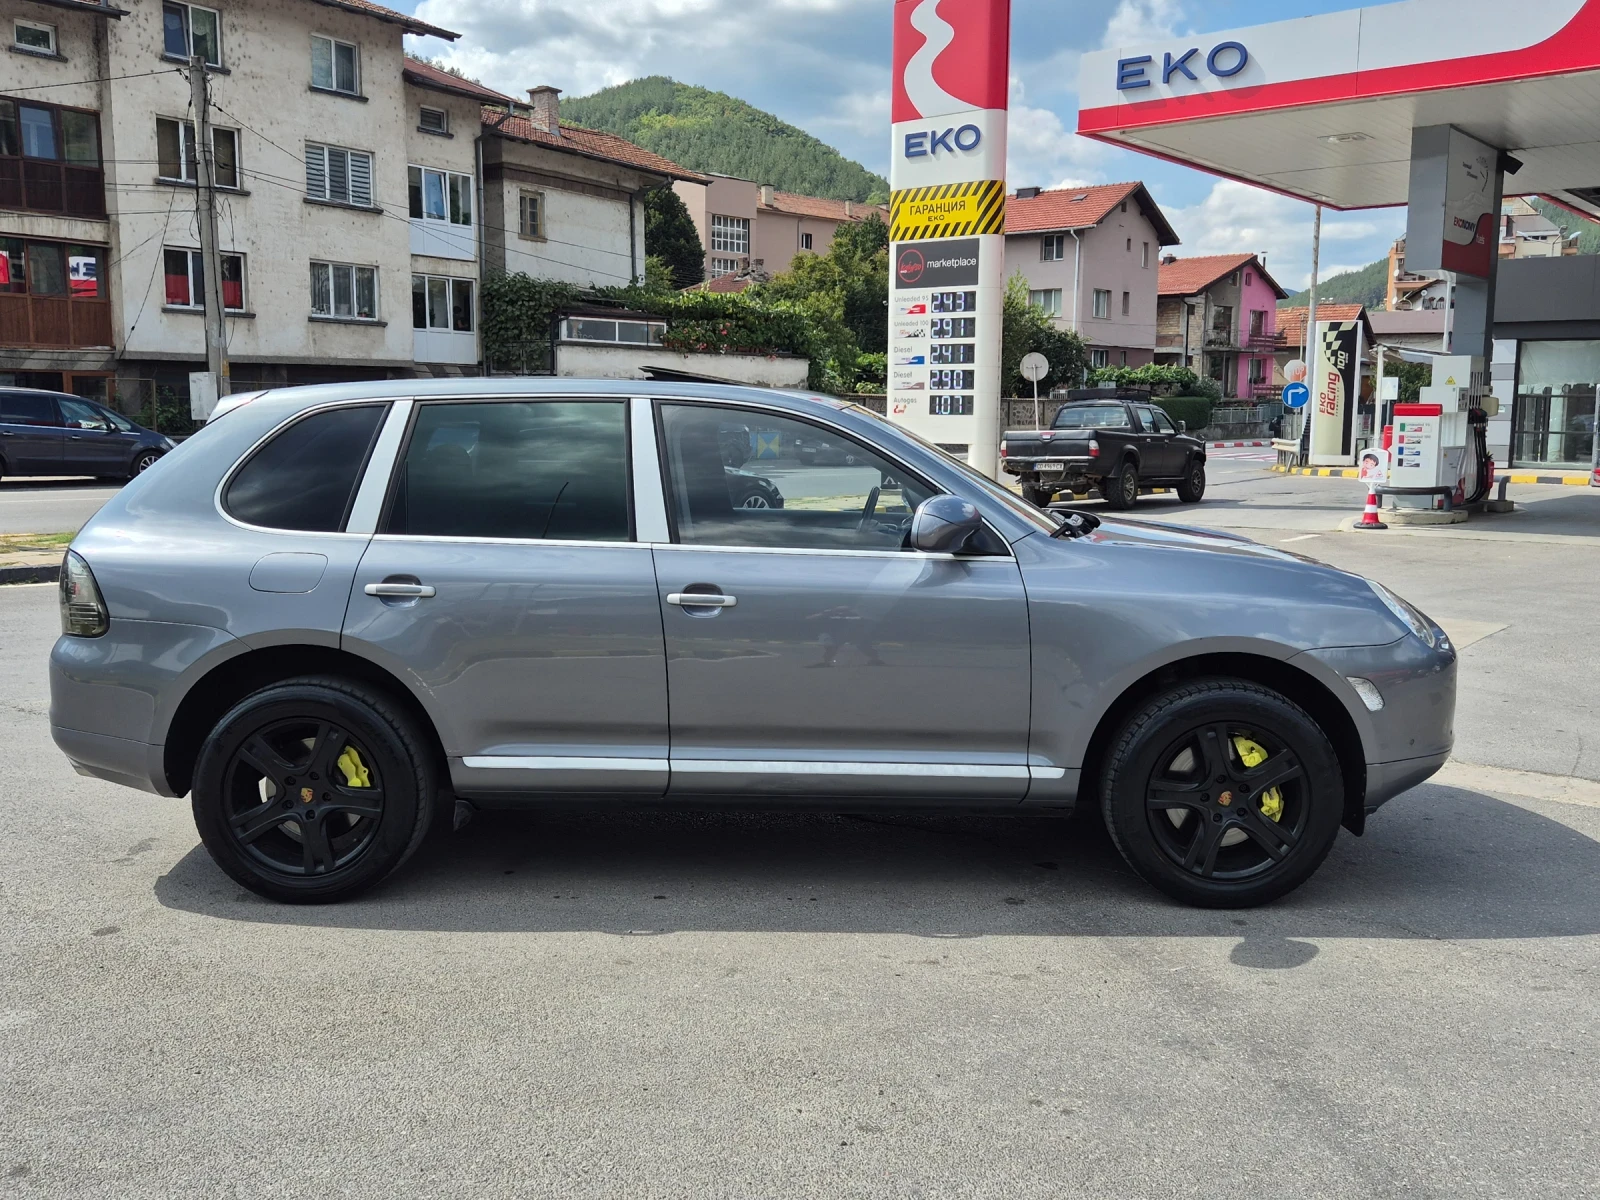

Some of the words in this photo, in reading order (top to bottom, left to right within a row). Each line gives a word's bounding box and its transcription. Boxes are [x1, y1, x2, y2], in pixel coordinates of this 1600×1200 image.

[1116, 41, 1248, 90] EKO
[905, 124, 981, 158] EKO
[909, 200, 966, 216] ГАРАНЦИЯ
[1454, 216, 1476, 232] EKONOMY
[927, 257, 977, 268] marketplace
[932, 292, 965, 312] 2.43
[931, 318, 964, 338] 2.91
[931, 344, 964, 364] 2.41
[1337, 351, 1346, 370] 100
[930, 370, 963, 389] 2.90
[894, 397, 917, 405] Autogas
[1319, 392, 1327, 413] EKO
[1326, 371, 1340, 416] racing
[935, 396, 963, 415] 1.07
